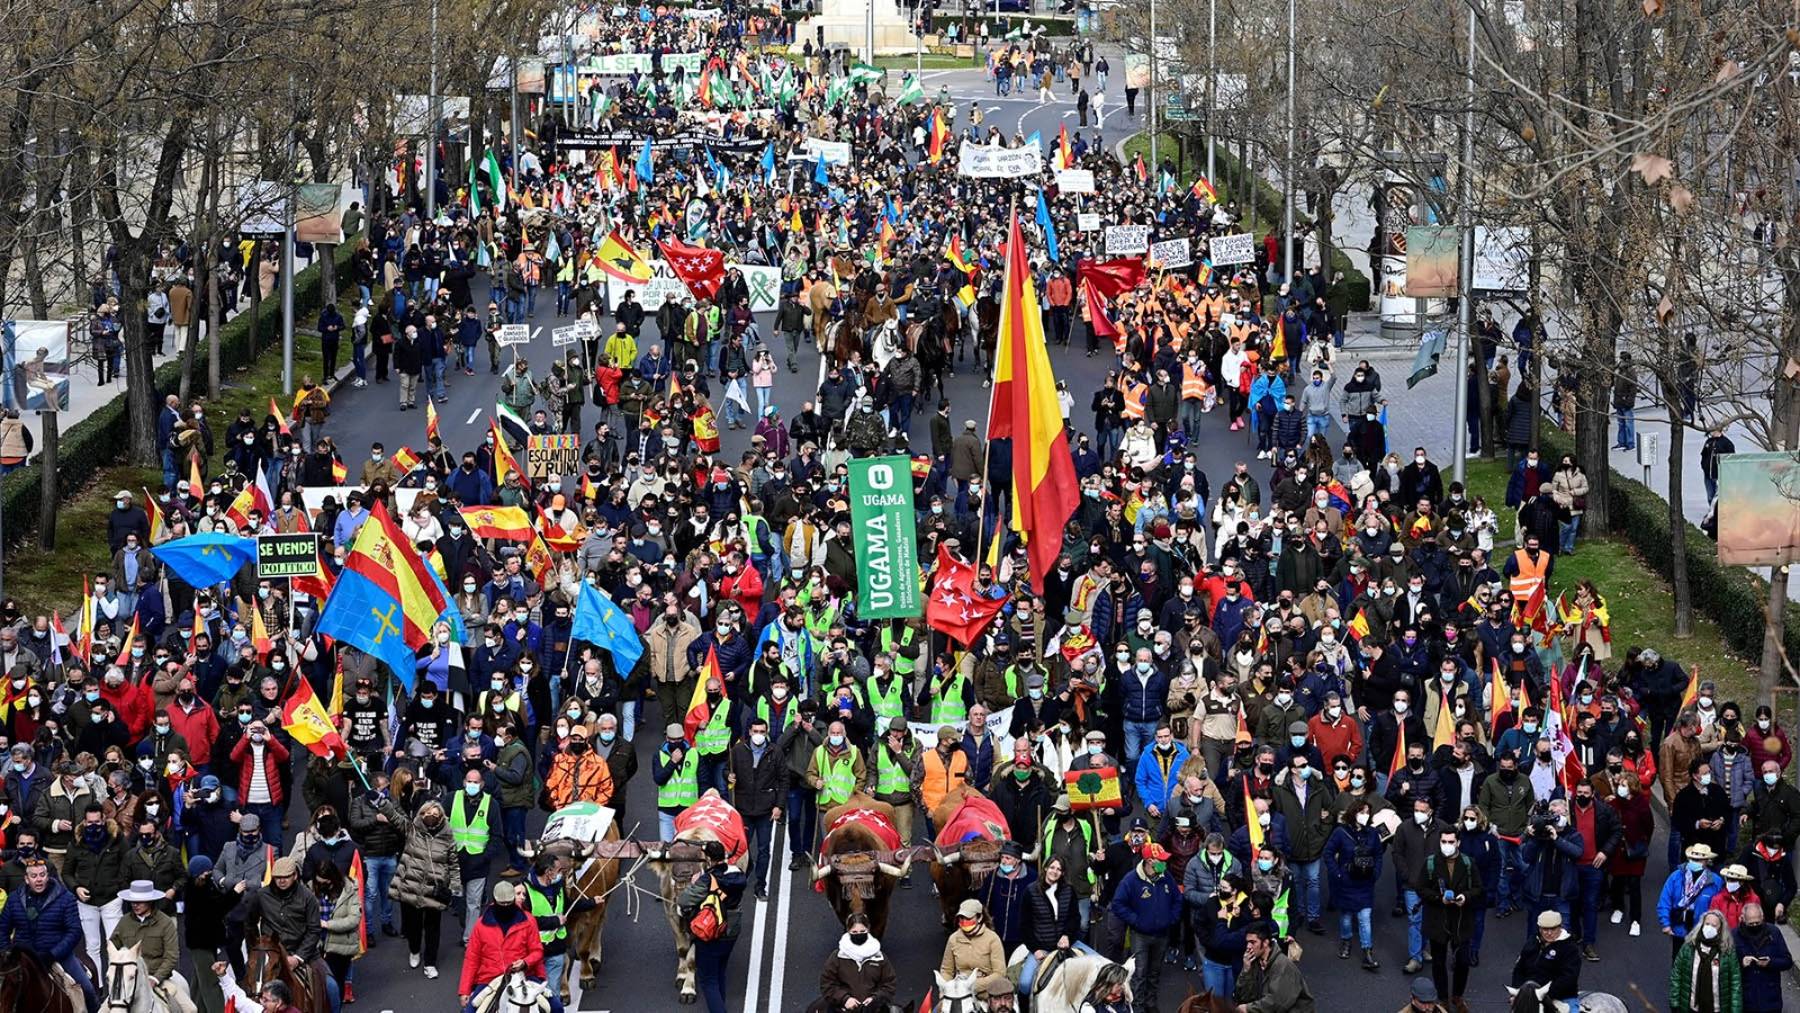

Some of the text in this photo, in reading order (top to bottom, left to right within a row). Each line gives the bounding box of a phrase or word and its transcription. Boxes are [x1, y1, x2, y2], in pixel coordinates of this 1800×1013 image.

[615, 56, 634, 70] SE
[529, 448, 580, 462] ESCLAVITUD
[534, 462, 579, 477] Y RUINA
[863, 494, 906, 506] UGAMA
[260, 541, 315, 556] SE VENDE
[261, 562, 316, 574] POLITICO
[866, 513, 894, 610] UGAMA
